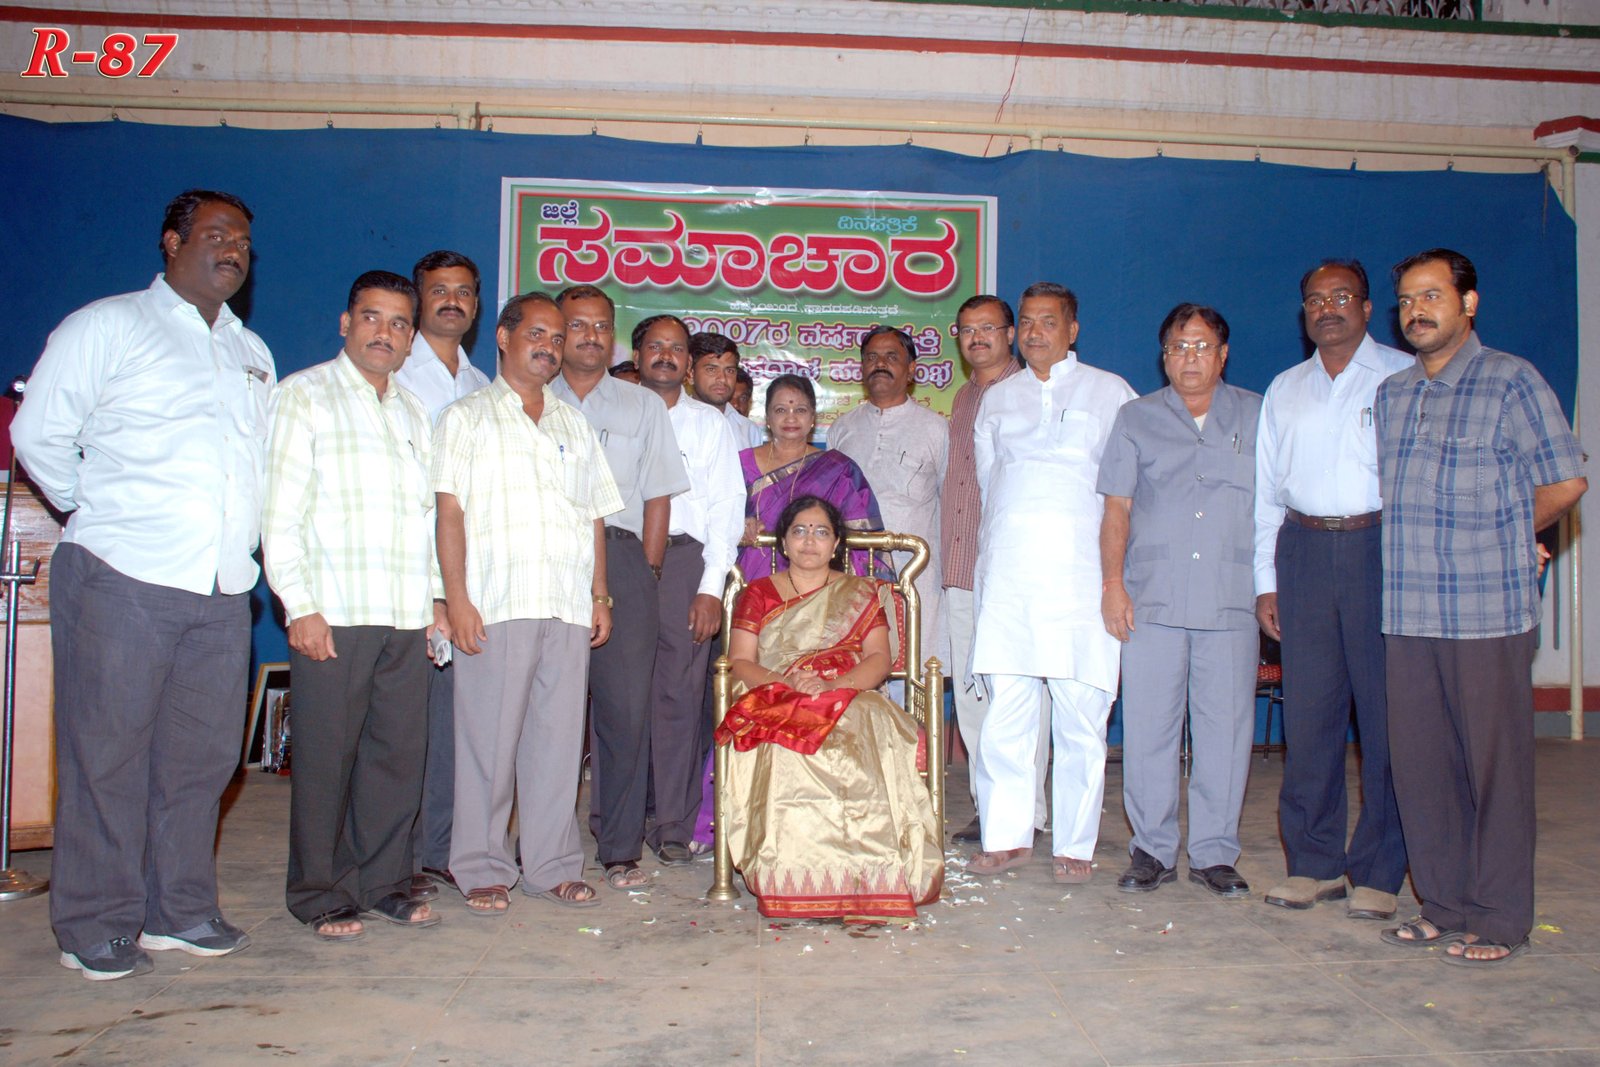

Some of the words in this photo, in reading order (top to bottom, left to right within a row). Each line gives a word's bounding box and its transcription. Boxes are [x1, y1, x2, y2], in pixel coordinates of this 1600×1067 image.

[541, 201, 578, 225] ಜಿಲ್ಲೆ
[838, 215, 917, 235] ದಿನಪತ್ರಿಕೆ
[538, 206, 957, 295] ಸಮಾಚಾರ
